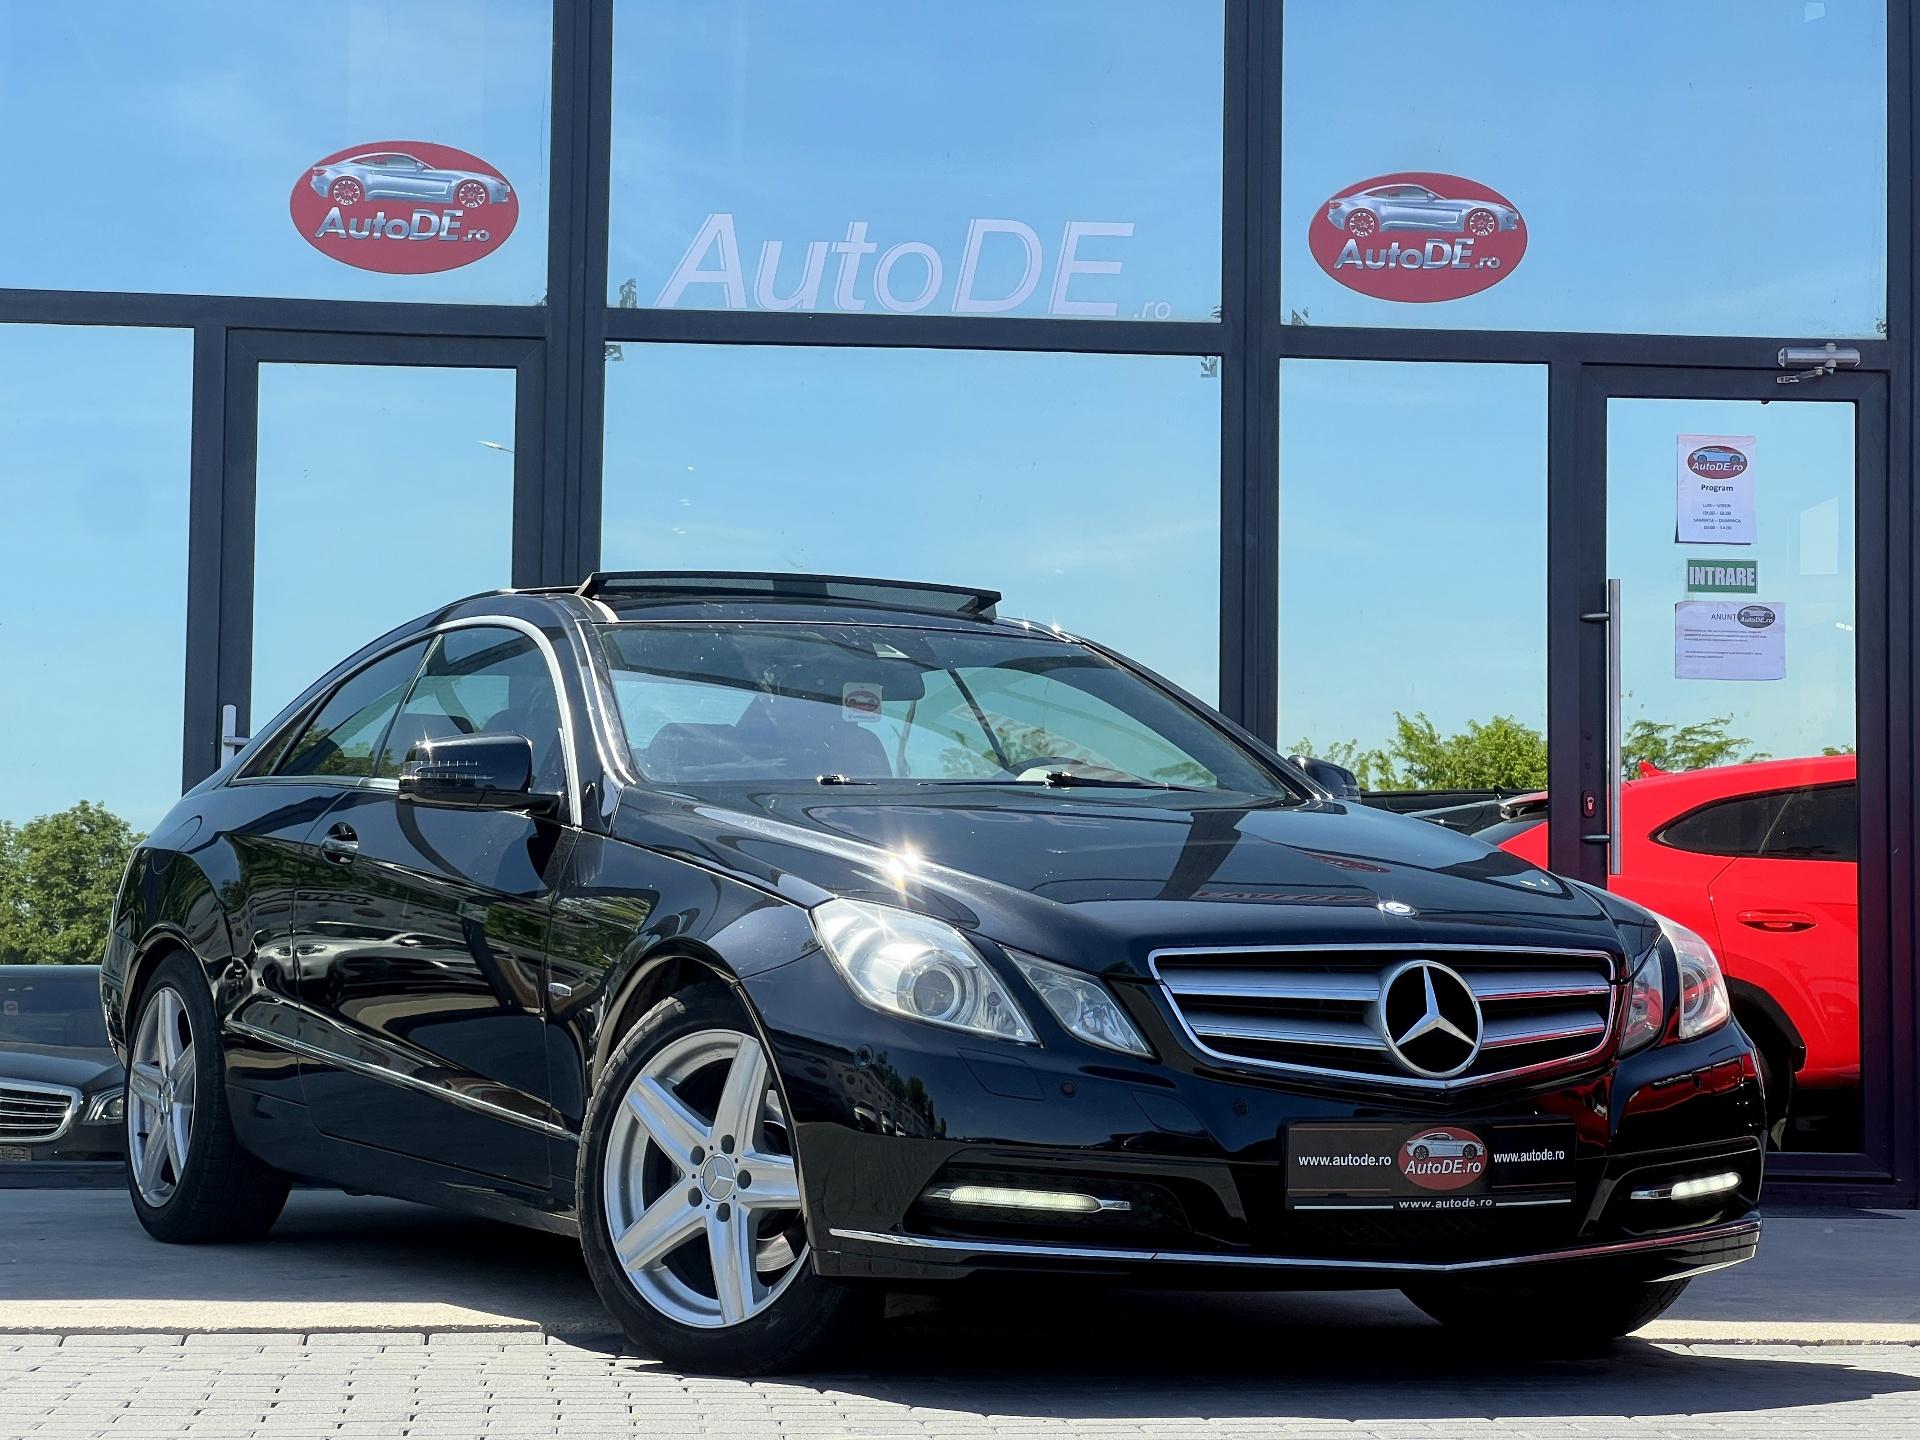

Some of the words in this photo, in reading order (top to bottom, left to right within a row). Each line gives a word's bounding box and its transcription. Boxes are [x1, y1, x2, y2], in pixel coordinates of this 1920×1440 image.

[1692, 462, 1744, 470] AutoDE.ro
[1701, 484, 1734, 492] Program
[1689, 566, 1755, 586] INTRARE
[1299, 1154, 1392, 1166] www.autode.ro
[1494, 1149, 1565, 1163] www.autode.ro
[1405, 1159, 1482, 1175] AutoDE.ro
[1399, 1198, 1492, 1209] www.autode.ro
